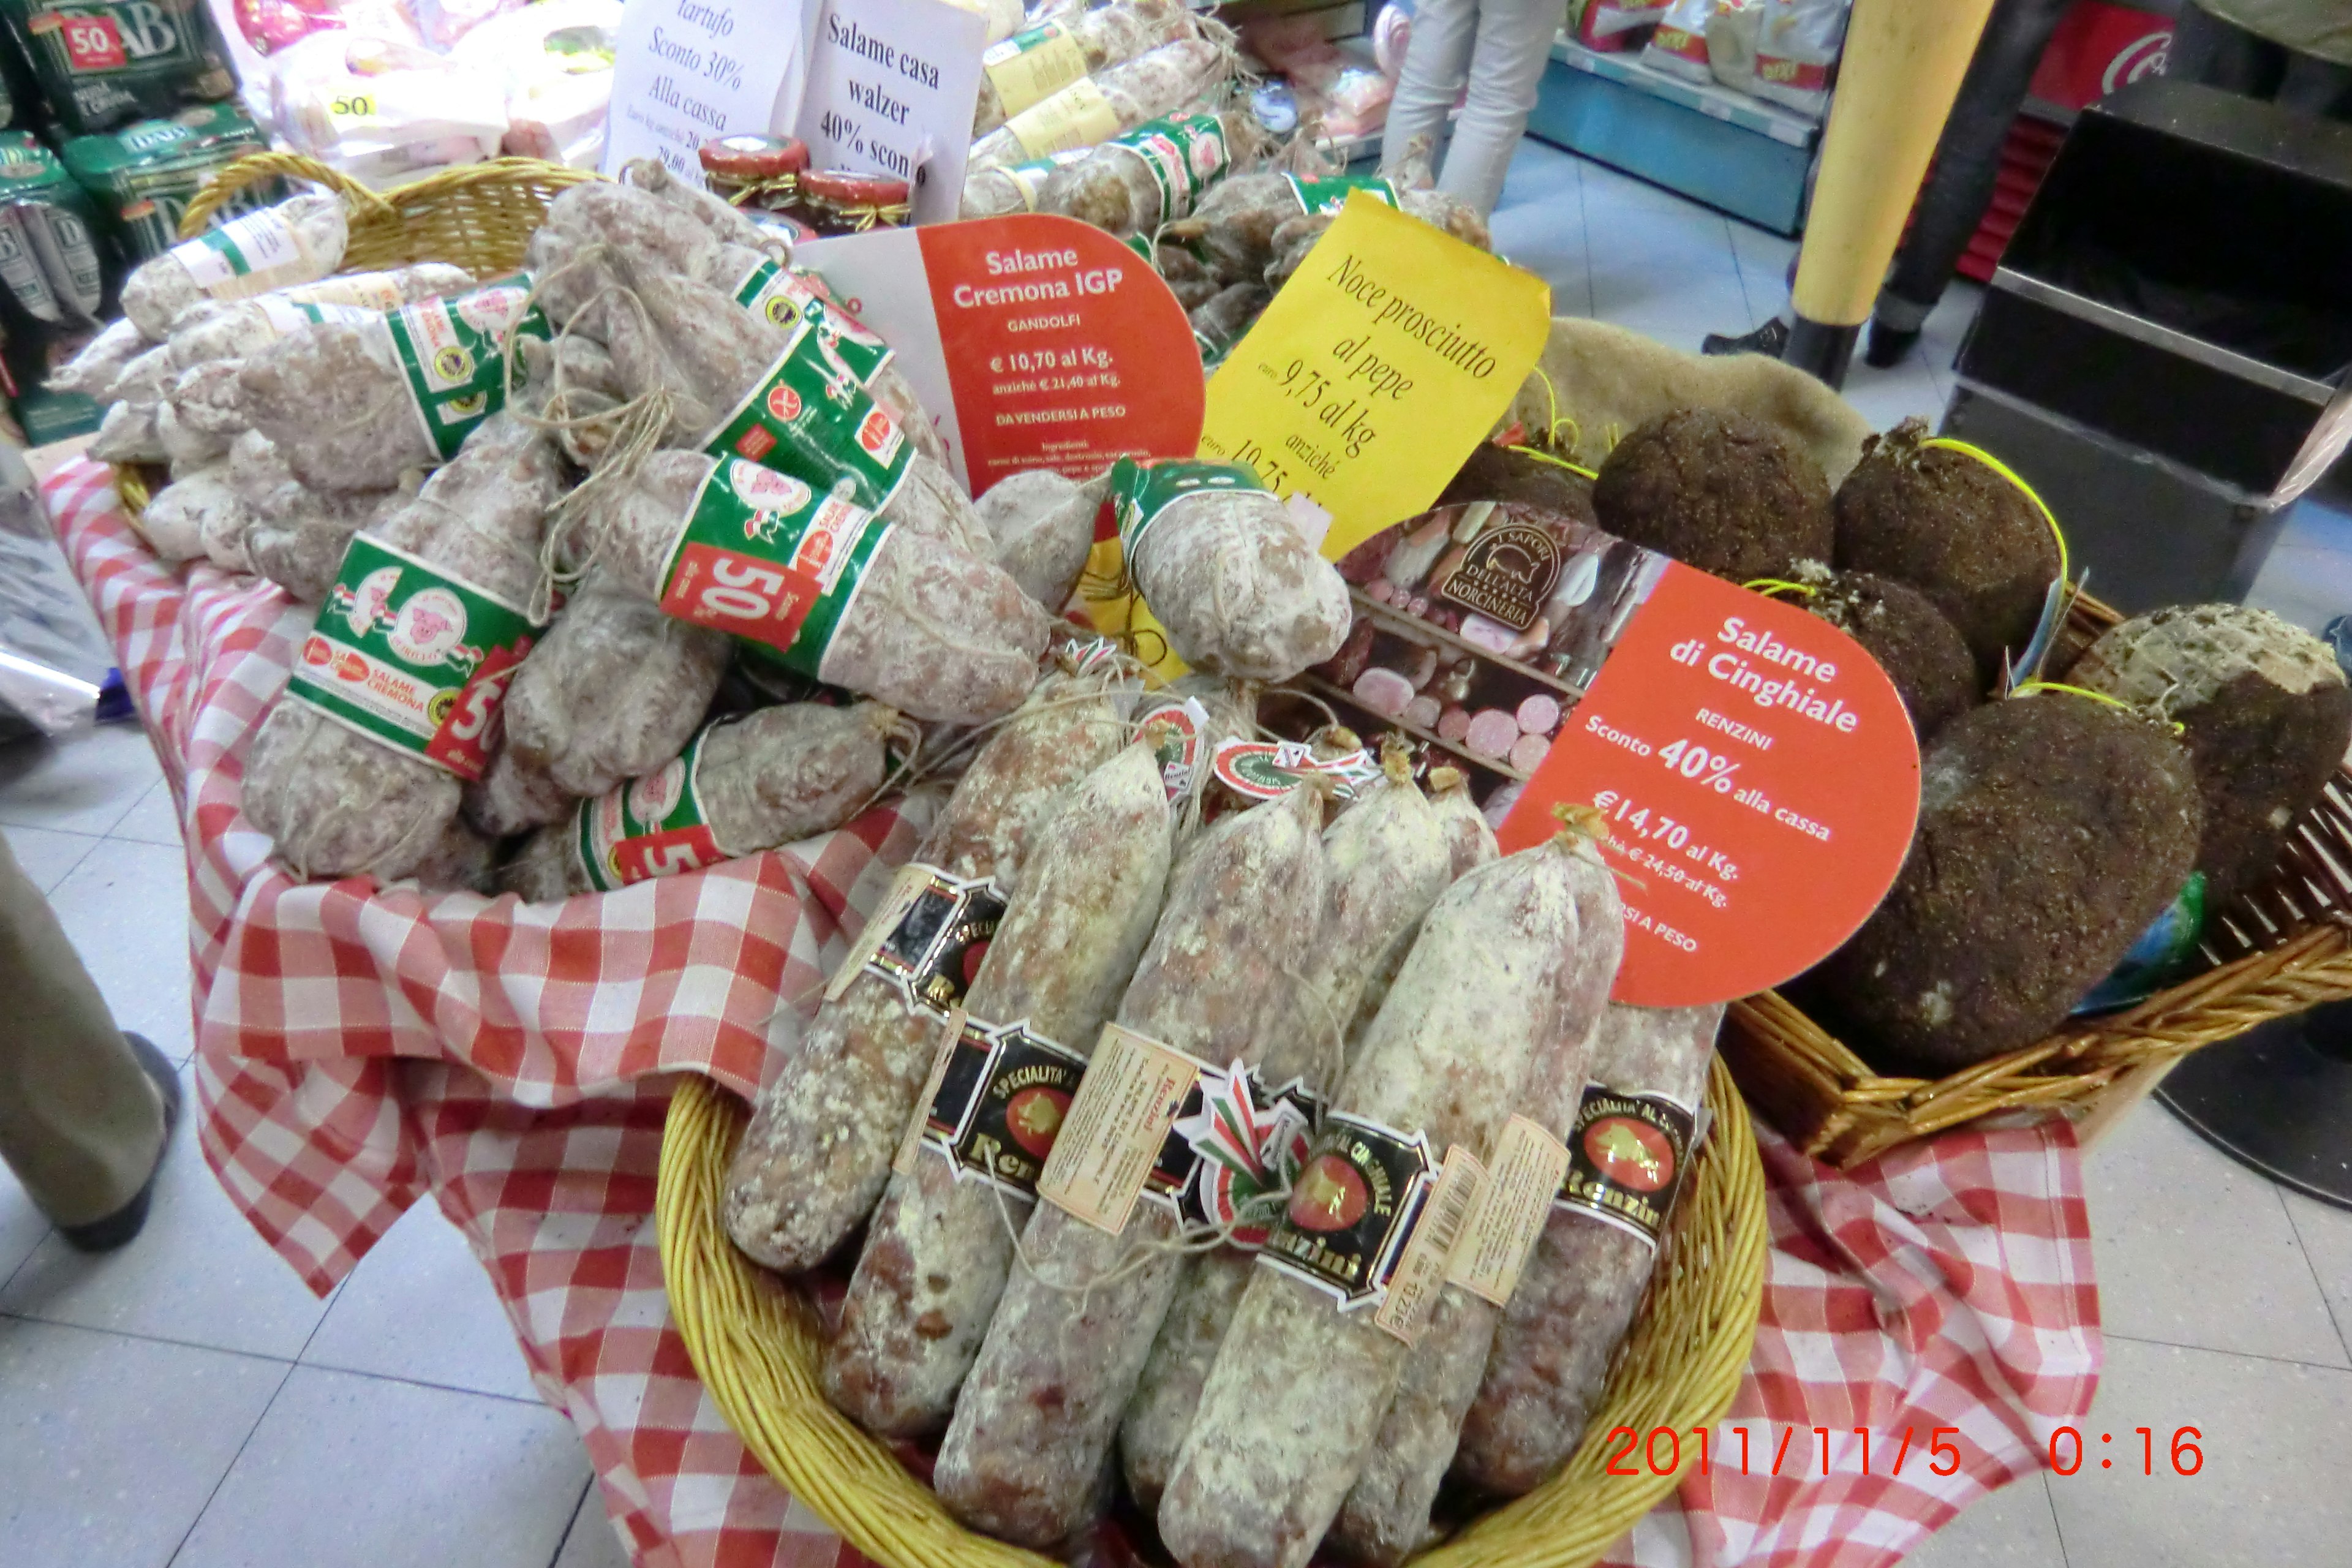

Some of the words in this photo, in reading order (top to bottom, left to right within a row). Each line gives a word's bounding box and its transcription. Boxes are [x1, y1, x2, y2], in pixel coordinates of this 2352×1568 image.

[649, 26, 701, 71] Sconto
[704, 51, 744, 91] 30%
[828, 13, 894, 69] Salame
[900, 53, 940, 90] casa
[649, 75, 680, 109] Alla
[683, 96, 727, 132] cassa
[849, 80, 910, 126] walzer
[821, 110, 864, 154] 40%
[986, 249, 1078, 276] Salame
[954, 279, 1070, 308] Cremona
[1075, 268, 1123, 296] IGP
[1007, 313, 1081, 333] GANDOLFI
[1327, 254, 1386, 308] Noce
[1373, 296, 1496, 380] prosciutto
[990, 356, 1003, 373] €
[1009, 352, 1057, 374] 10,70
[1061, 349, 1077, 367] al
[1081, 347, 1114, 371] Kg.
[1332, 334, 1370, 364] al
[1347, 351, 1415, 402] pepe
[995, 413, 1014, 426] DA
[1016, 410, 1079, 424] VENDERSI
[1079, 408, 1090, 420] A
[1092, 405, 1126, 420] PESO
[1257, 362, 1278, 379] euro
[1280, 359, 1331, 408] 9,75
[1320, 399, 1354, 429] al
[1342, 409, 1378, 459] kg
[1200, 434, 1226, 457] euro
[1285, 431, 1336, 480] anziché
[1509, 531, 1551, 560] SAPORI
[1448, 579, 1527, 625] NORCINERIA
[1716, 616, 1836, 683] Salame
[1670, 638, 1705, 668] di
[1708, 653, 1858, 733] Cinghiale
[1695, 707, 1774, 752] RENZINI
[1585, 715, 1651, 757] Sconto
[1658, 737, 1740, 794] 40%
[1733, 787, 1770, 815] alla
[1774, 807, 1831, 842] cassa
[1686, 845, 1709, 861] al
[1708, 851, 1738, 881] Kg.
[1638, 916, 1651, 930] A
[1654, 922, 1697, 952] PESO
